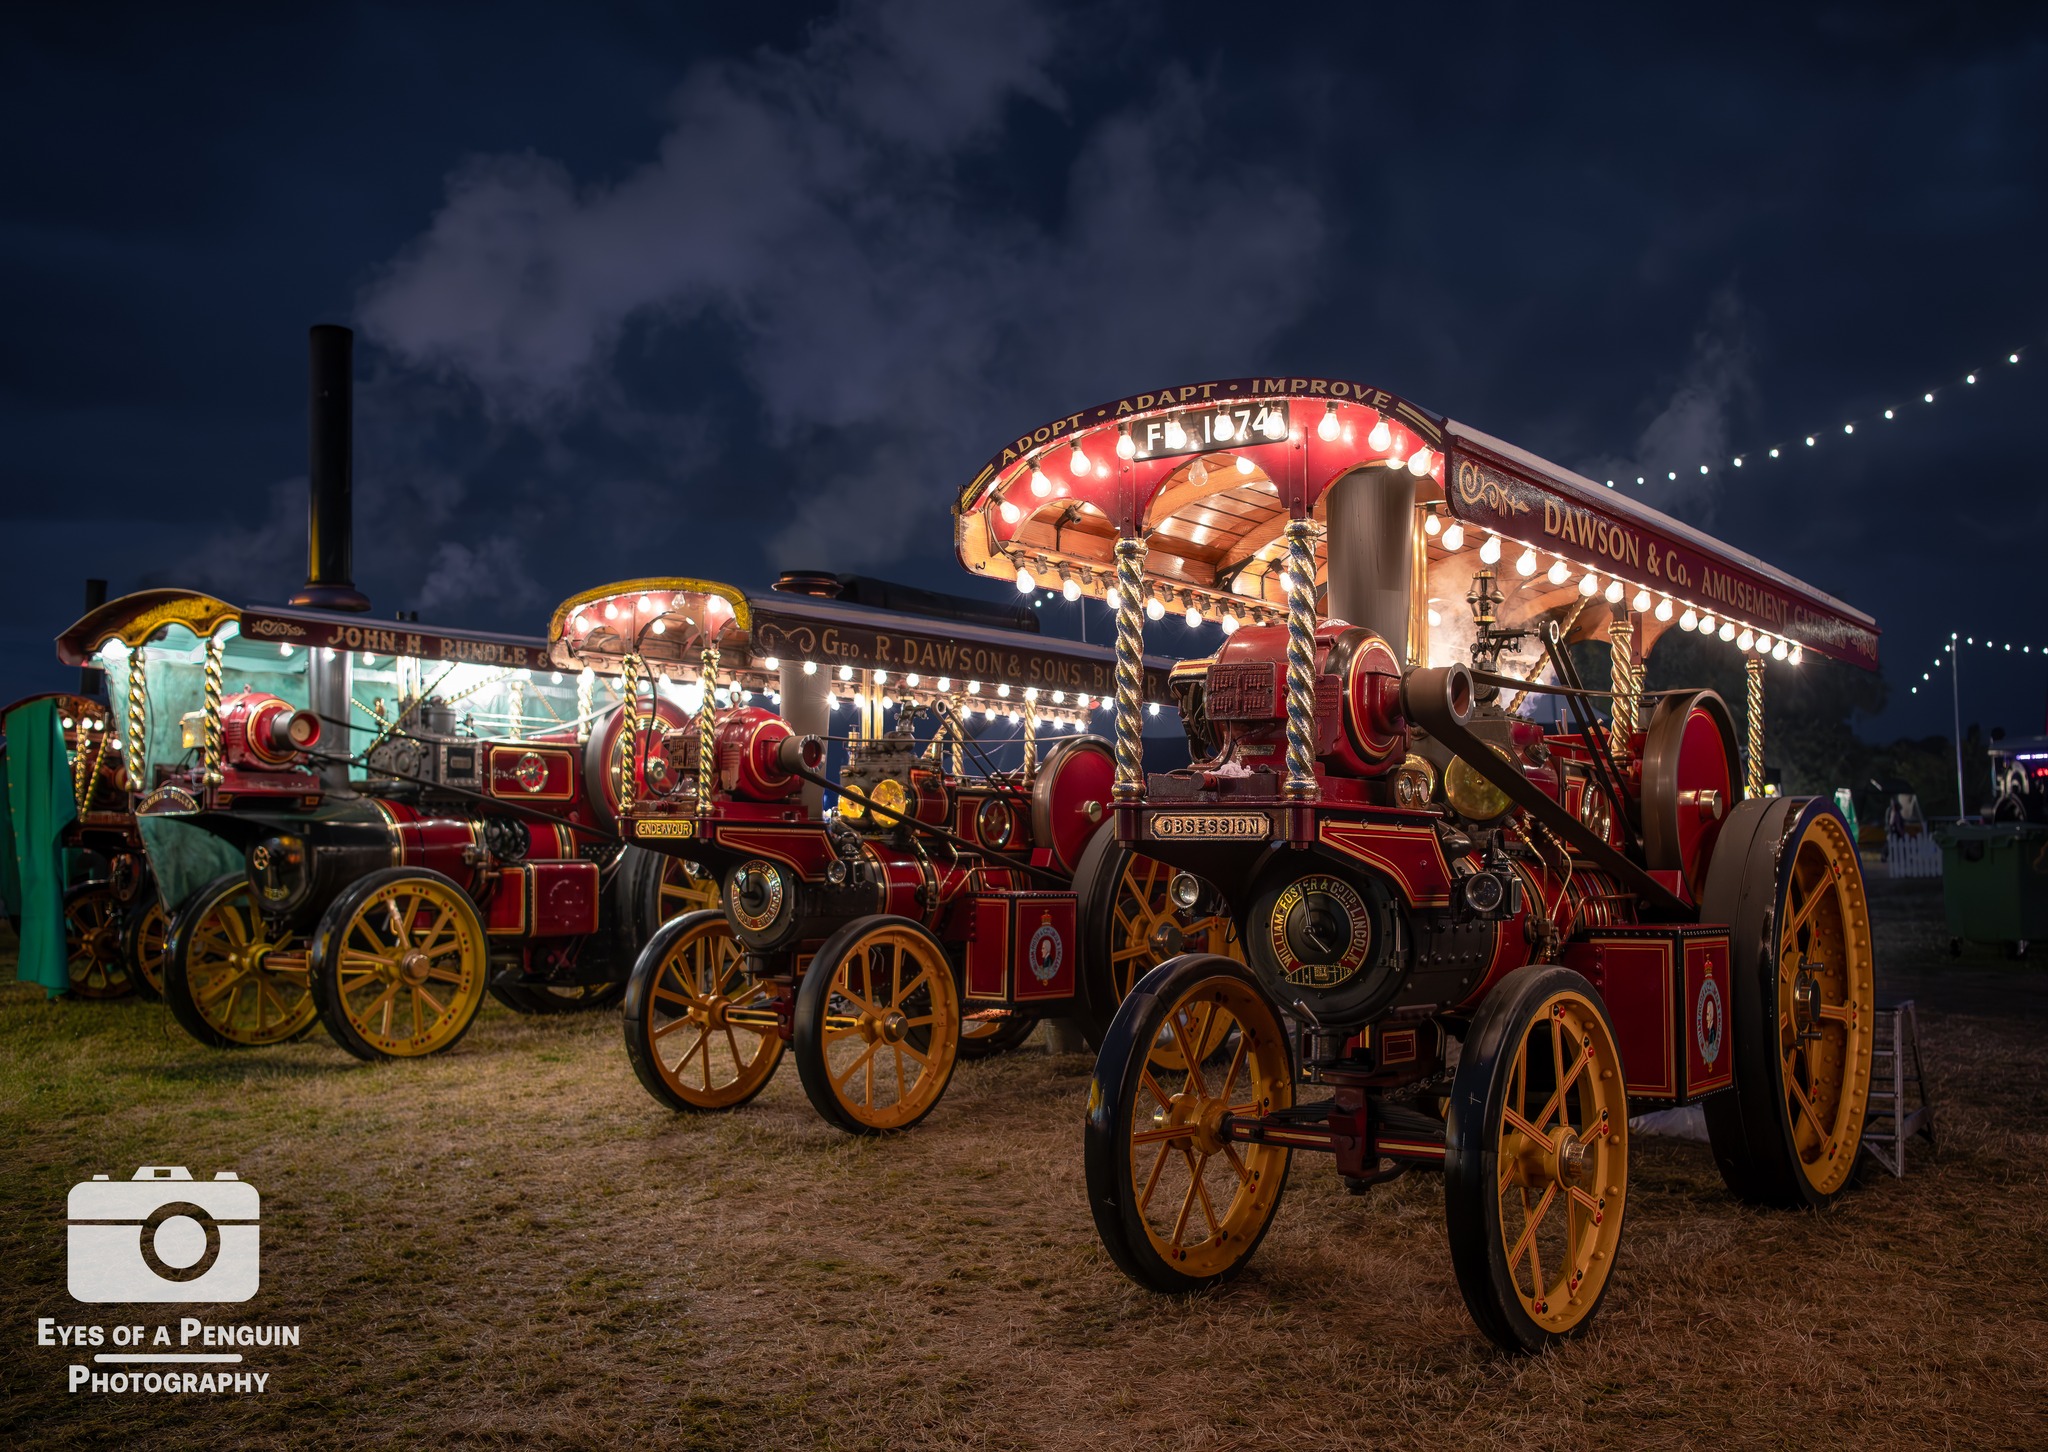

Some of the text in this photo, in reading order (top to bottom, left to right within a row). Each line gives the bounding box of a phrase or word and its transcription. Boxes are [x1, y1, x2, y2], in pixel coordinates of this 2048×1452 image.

[1001, 379, 1392, 467] ADOPT ADAPT IMPROVE
[1205, 408, 1271, 444] 174
[1544, 499, 1640, 569] DAWSON
[1647, 542, 1661, 577] &
[1702, 566, 1789, 629] AMUSEMENT
[328, 626, 395, 652] JOHN
[406, 634, 428, 656] H.
[440, 638, 527, 666] RUNDLE
[875, 635, 898, 663] R.
[903, 639, 1003, 675] DAWSON
[1007, 654, 1022, 678] &
[639, 821, 690, 836] ENDEAVOUR
[1161, 818, 1259, 834] OBSESSION
[1274, 913, 1293, 967] WILLIAM
[1320, 879, 1328, 890] &
